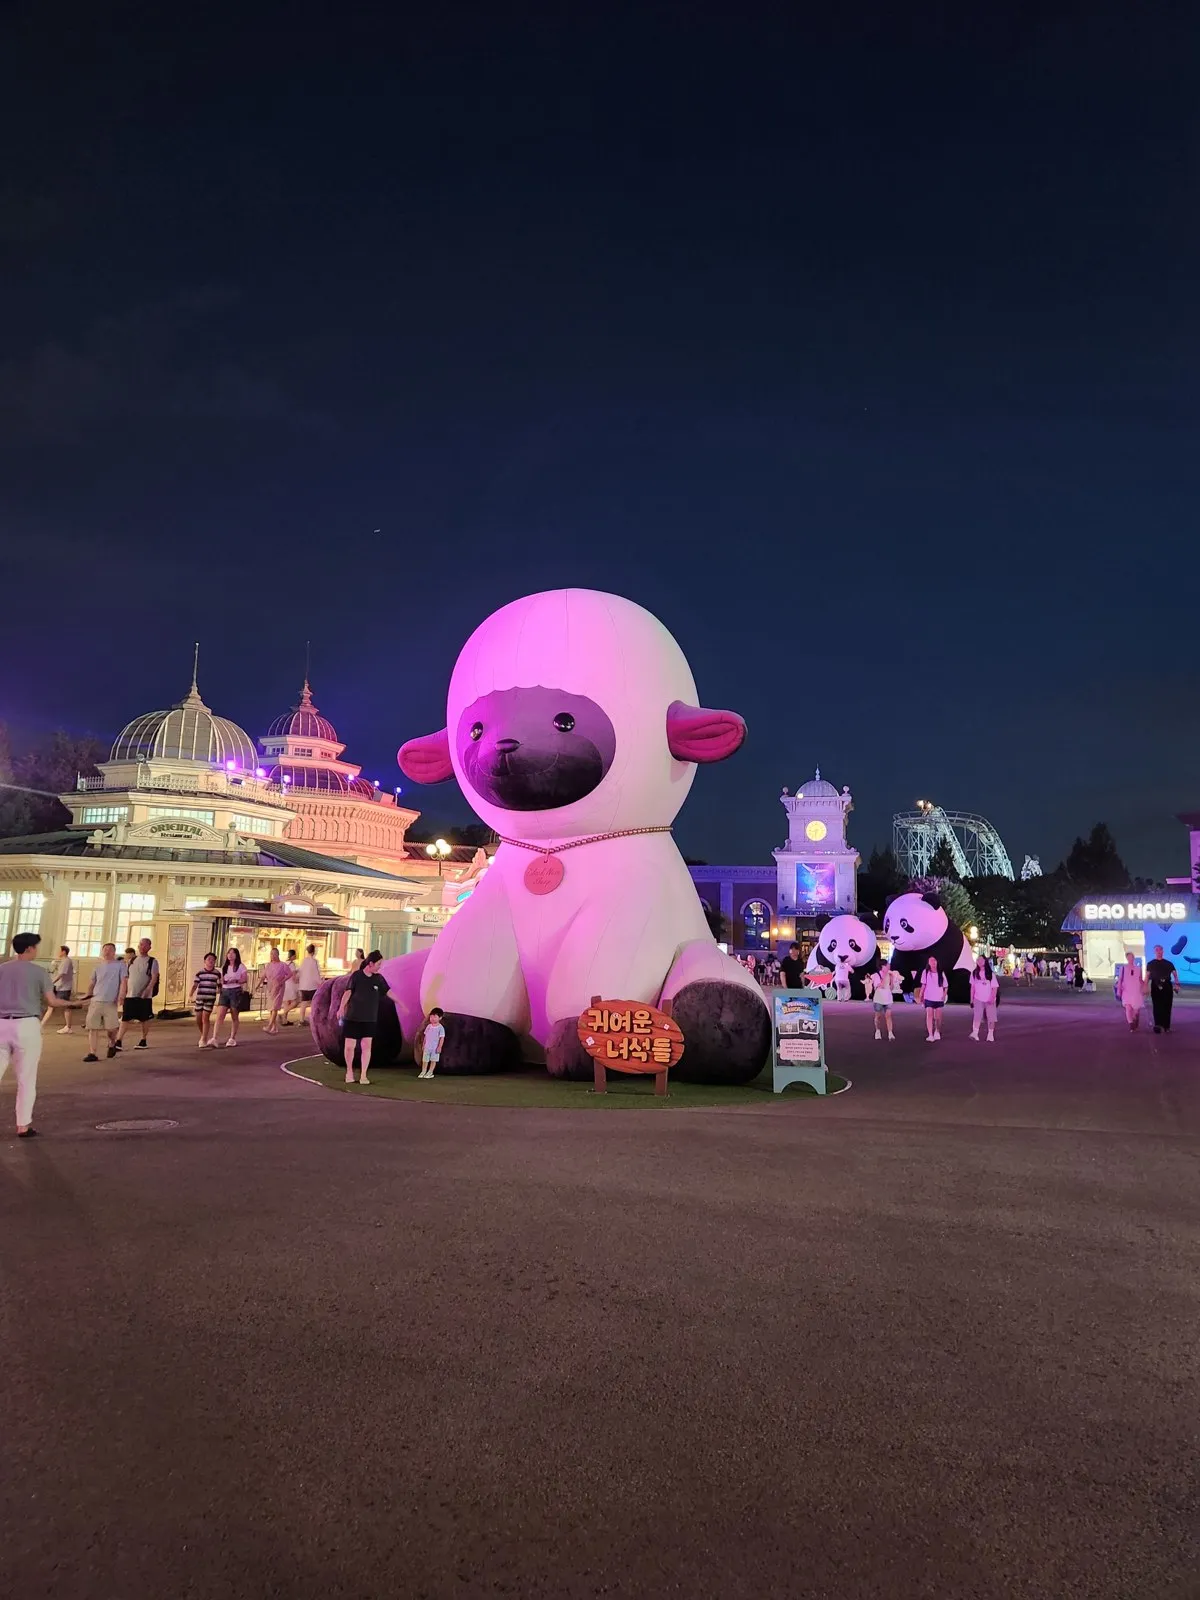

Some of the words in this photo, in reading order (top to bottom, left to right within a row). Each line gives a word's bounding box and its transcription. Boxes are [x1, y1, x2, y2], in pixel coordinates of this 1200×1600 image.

[150, 823, 203, 836] ORIENTAL
[1084, 904, 1125, 919] BAO
[1127, 902, 1186, 919] HAUS
[588, 1009, 653, 1034] 귀여운
[606, 1037, 672, 1063] 녀석들
